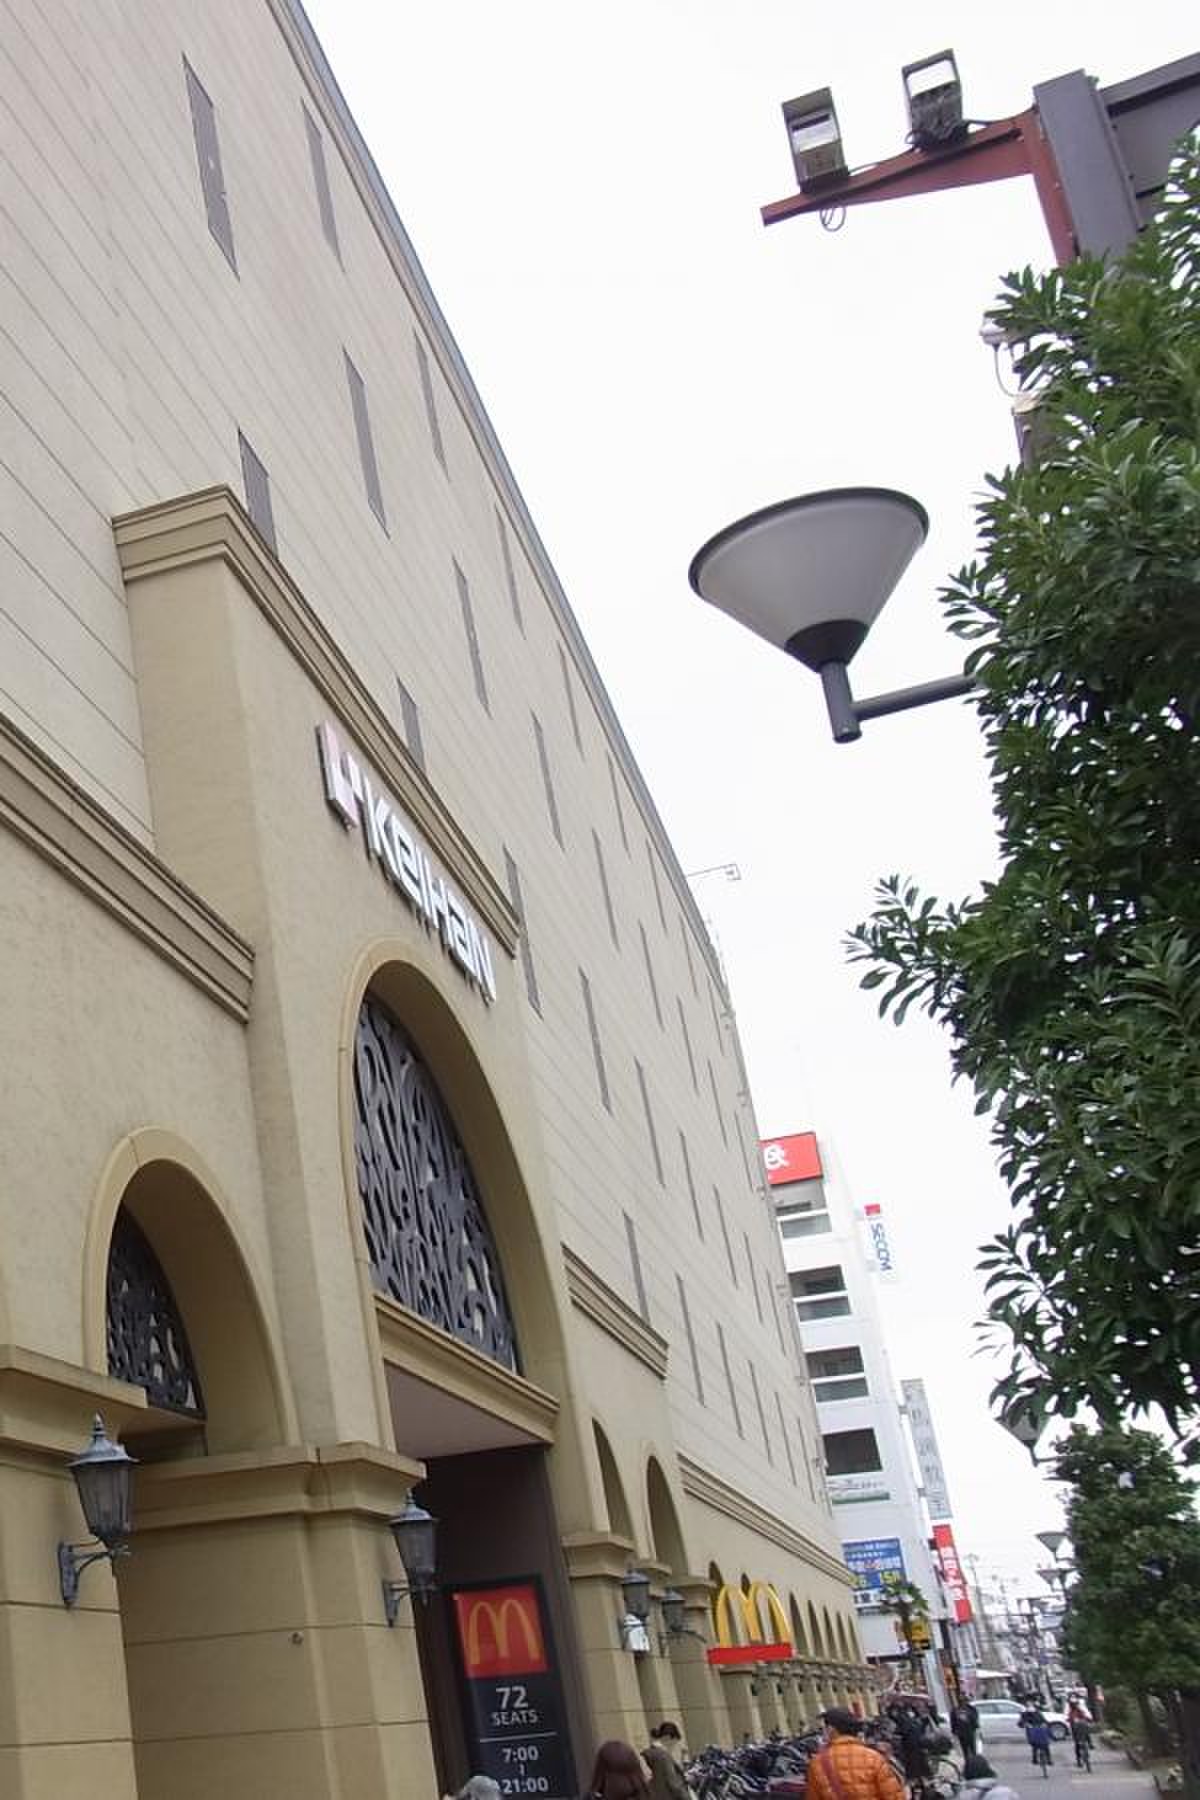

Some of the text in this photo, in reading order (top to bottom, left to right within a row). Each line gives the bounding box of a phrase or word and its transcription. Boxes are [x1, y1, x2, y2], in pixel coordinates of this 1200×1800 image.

[495, 1686, 529, 1709] 72
[491, 1709, 539, 1726] SEATS
[502, 1746, 539, 1763] 7:00
[502, 1777, 549, 1795] 21:00
